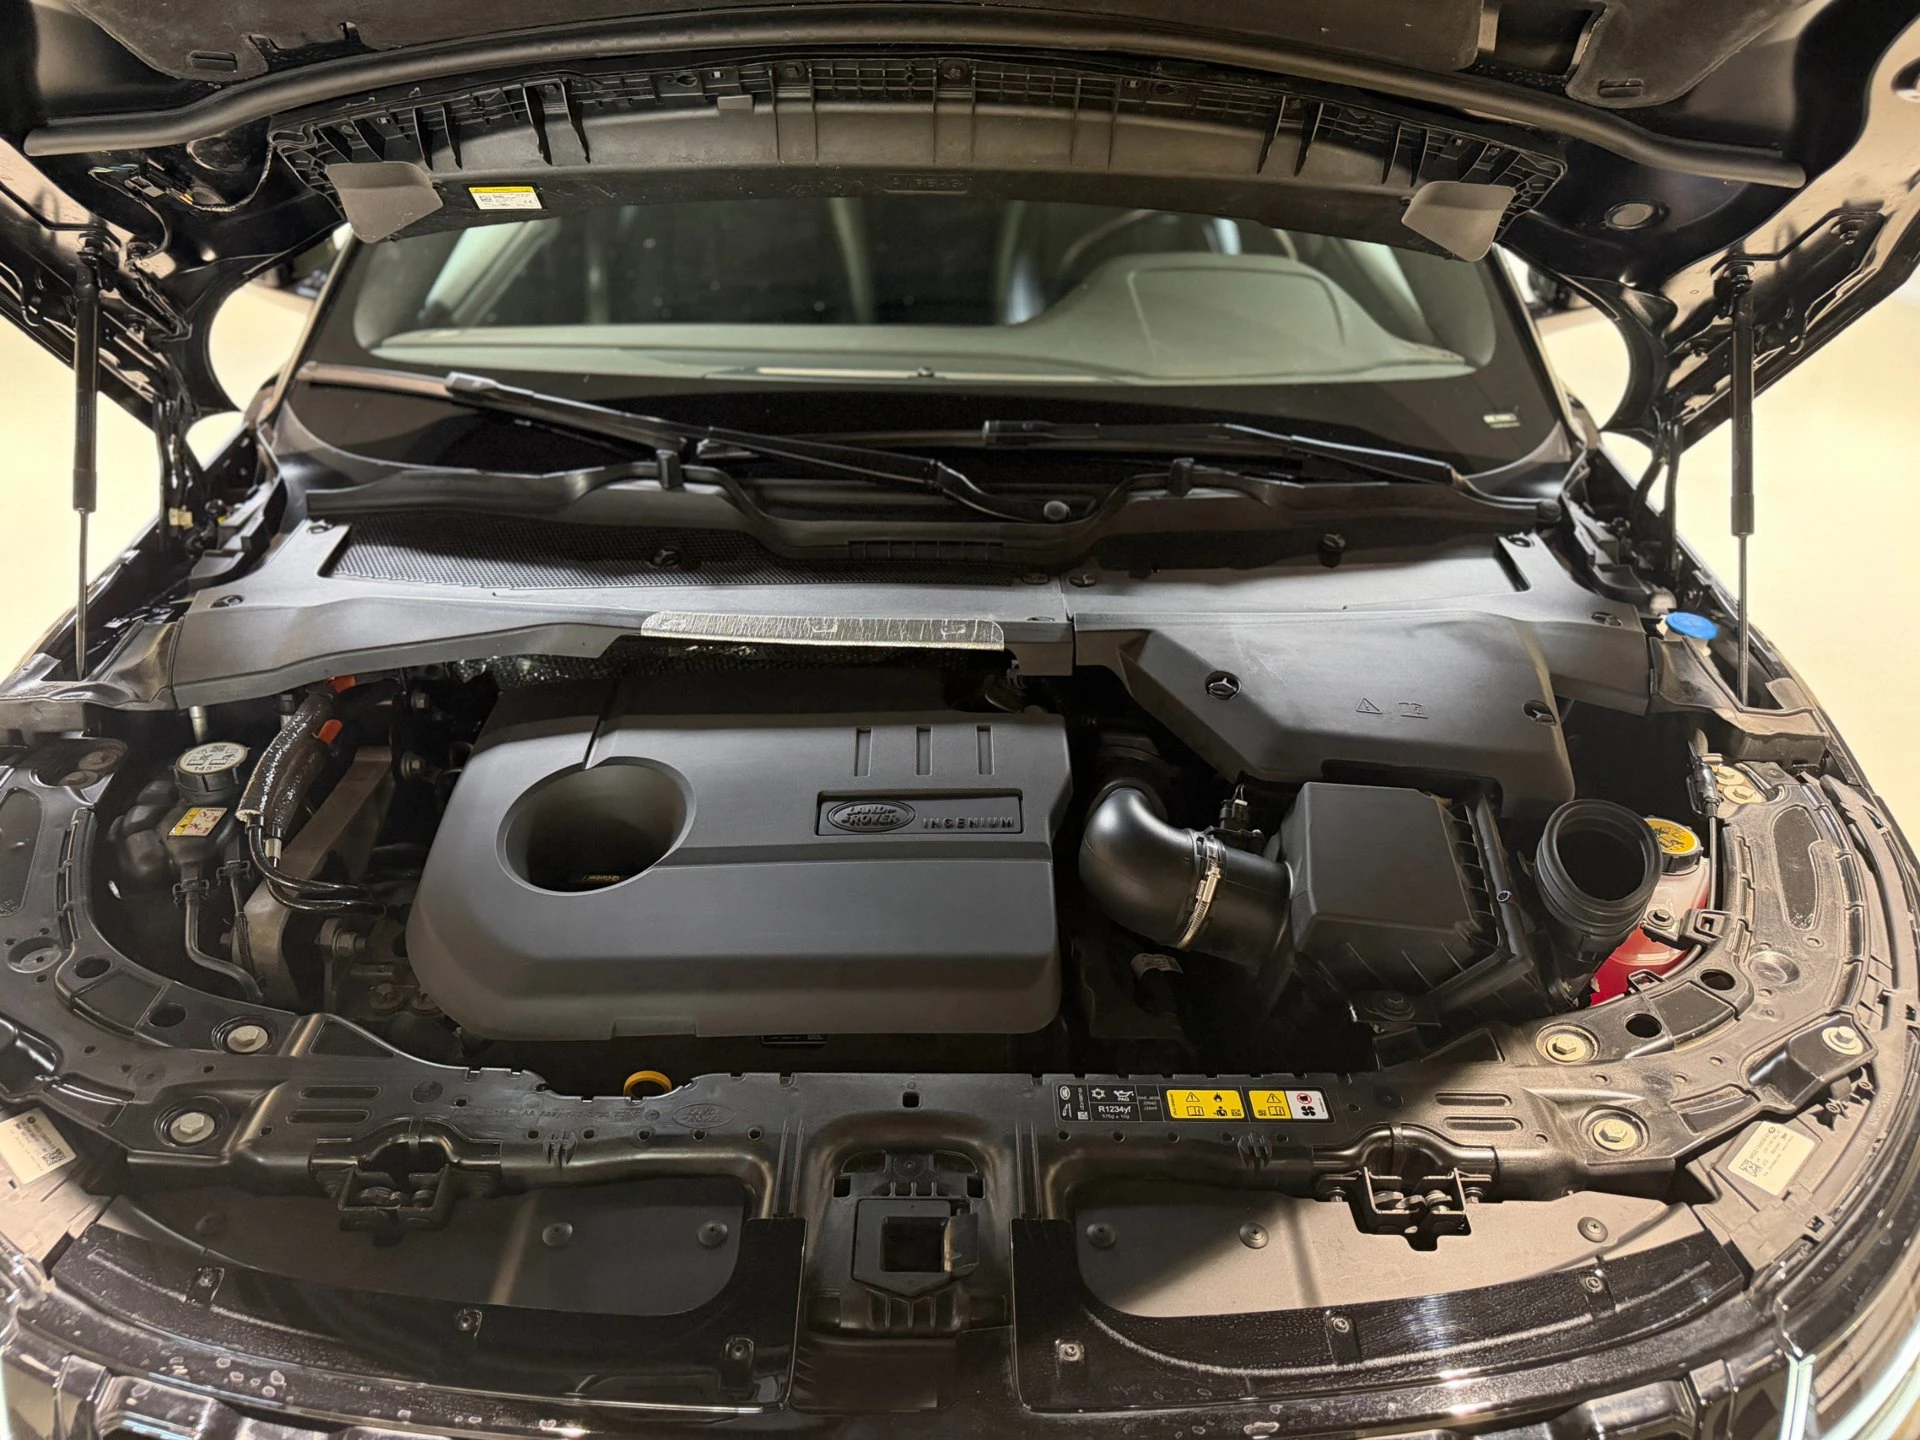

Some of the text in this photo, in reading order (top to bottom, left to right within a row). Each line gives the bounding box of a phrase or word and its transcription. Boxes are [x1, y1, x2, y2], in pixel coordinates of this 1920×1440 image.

[847, 806, 885, 815] LAND
[847, 814, 899, 827] ROVER
[922, 817, 1015, 830] INGENIUM
[1098, 1105, 1131, 1114] R1234yf
